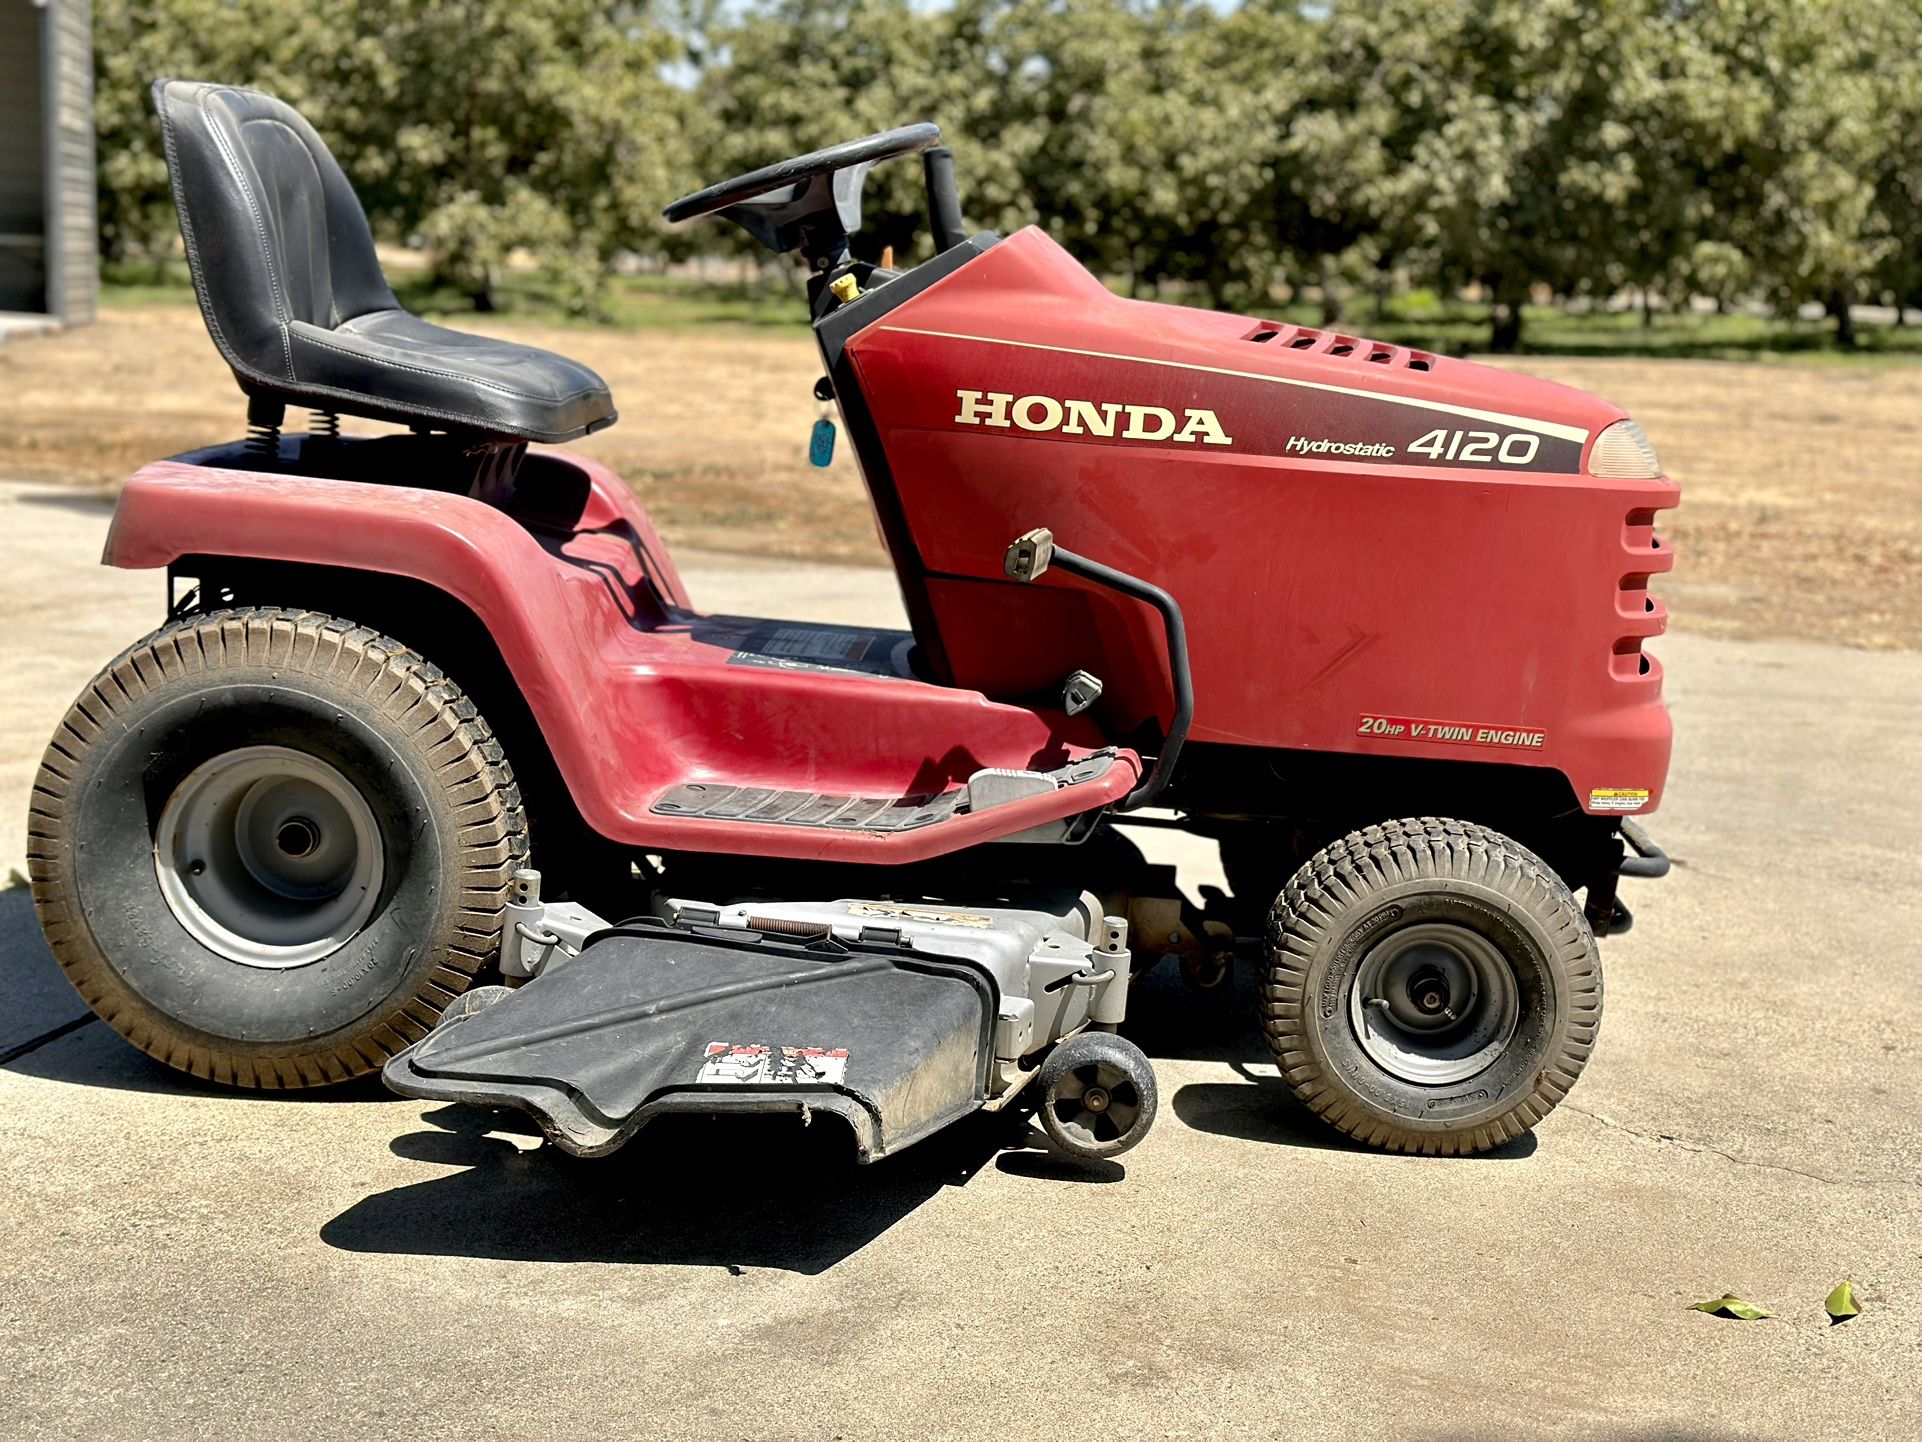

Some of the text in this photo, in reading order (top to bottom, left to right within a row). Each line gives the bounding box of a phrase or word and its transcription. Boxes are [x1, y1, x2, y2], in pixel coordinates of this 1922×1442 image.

[954, 389, 1233, 446] HONDA
[1286, 429, 1541, 465] Hydrostatic 4120
[1358, 717, 1545, 747] 20HP V-TWIN ENGINE
